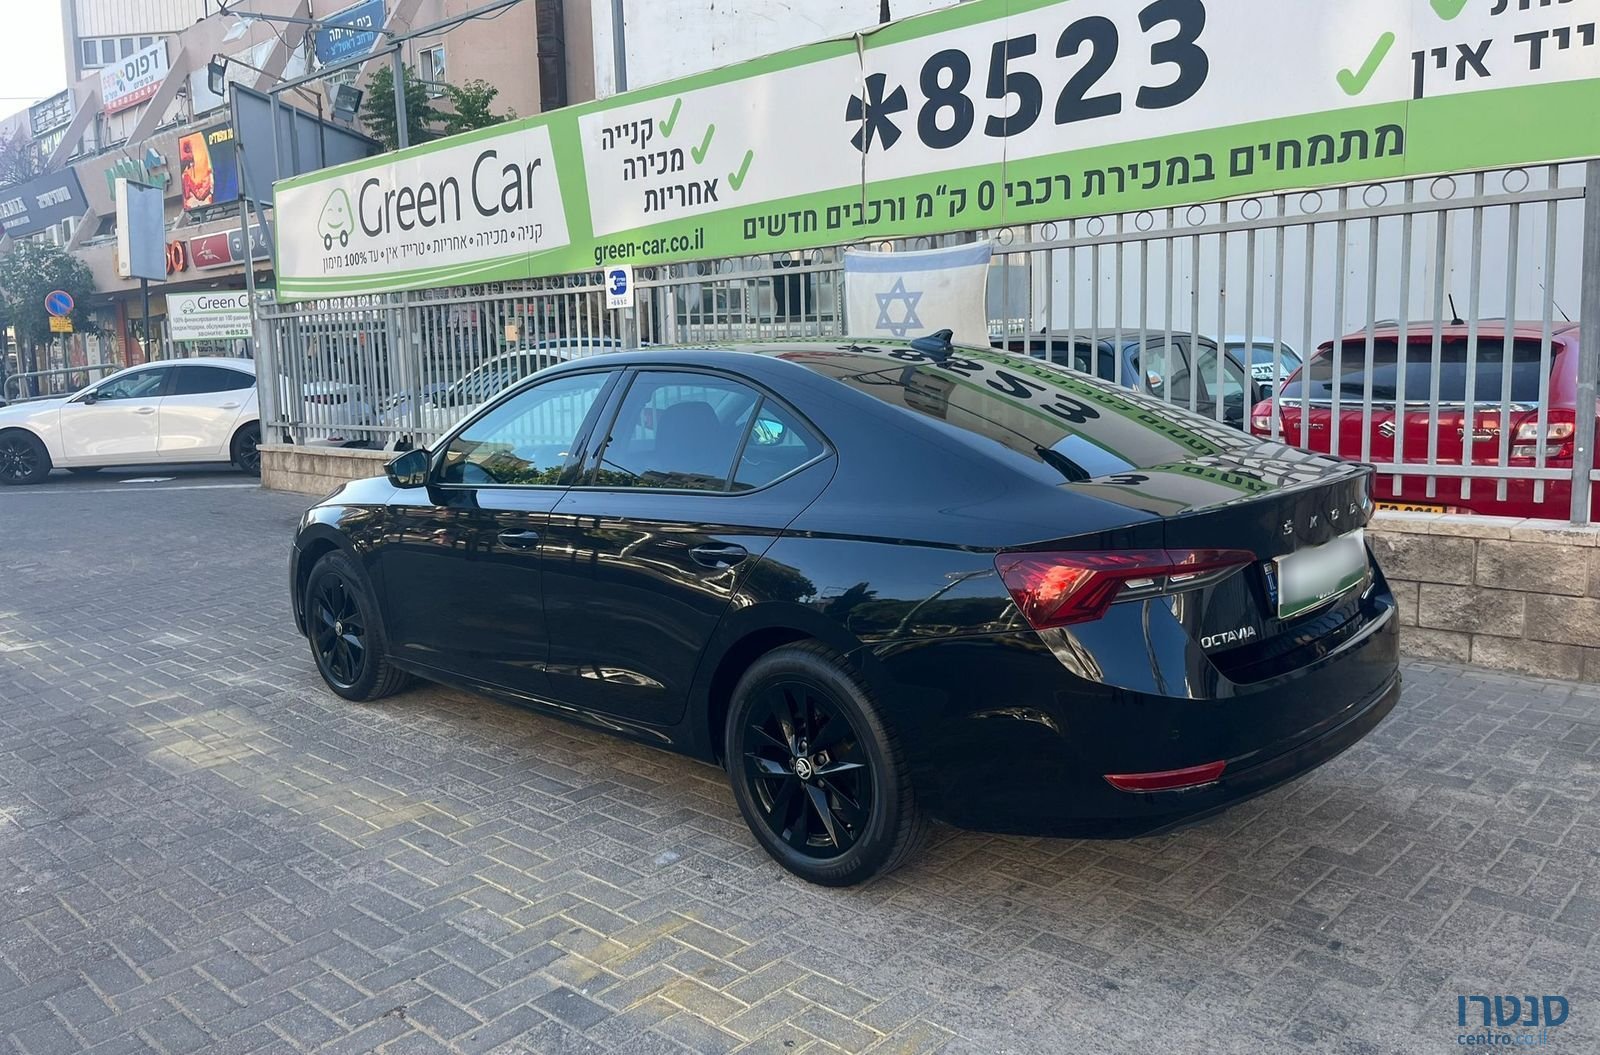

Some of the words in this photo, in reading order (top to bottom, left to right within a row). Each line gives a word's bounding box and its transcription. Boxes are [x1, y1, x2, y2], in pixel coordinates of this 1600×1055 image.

[125, 49, 158, 82] דפוס
[1411, 39, 1493, 99] אין
[602, 118, 653, 151] קנייה
[1230, 123, 1404, 177] מתמחים
[623, 148, 684, 181] מכירה
[1081, 152, 1215, 199] במכירת
[359, 176, 461, 238] Green
[471, 149, 541, 217] Car
[643, 178, 719, 213] אחריות
[977, 180, 995, 211] 0
[1004, 174, 1071, 207] רכבי
[744, 210, 817, 240] חדשים
[826, 196, 905, 230] ורכבים
[433, 235, 468, 253] אחריות
[476, 229, 508, 247] מכירה
[517, 223, 543, 243] קניה
[594, 227, 704, 265] green-car.co.il
[322, 255, 343, 273] מימון
[345, 252, 367, 266] 100%
[368, 250, 379, 262] עד
[385, 246, 398, 264] אין
[401, 242, 425, 258] טרייד
[197, 296, 235, 309] Green
[1201, 626, 1256, 648] OCTAVIA
